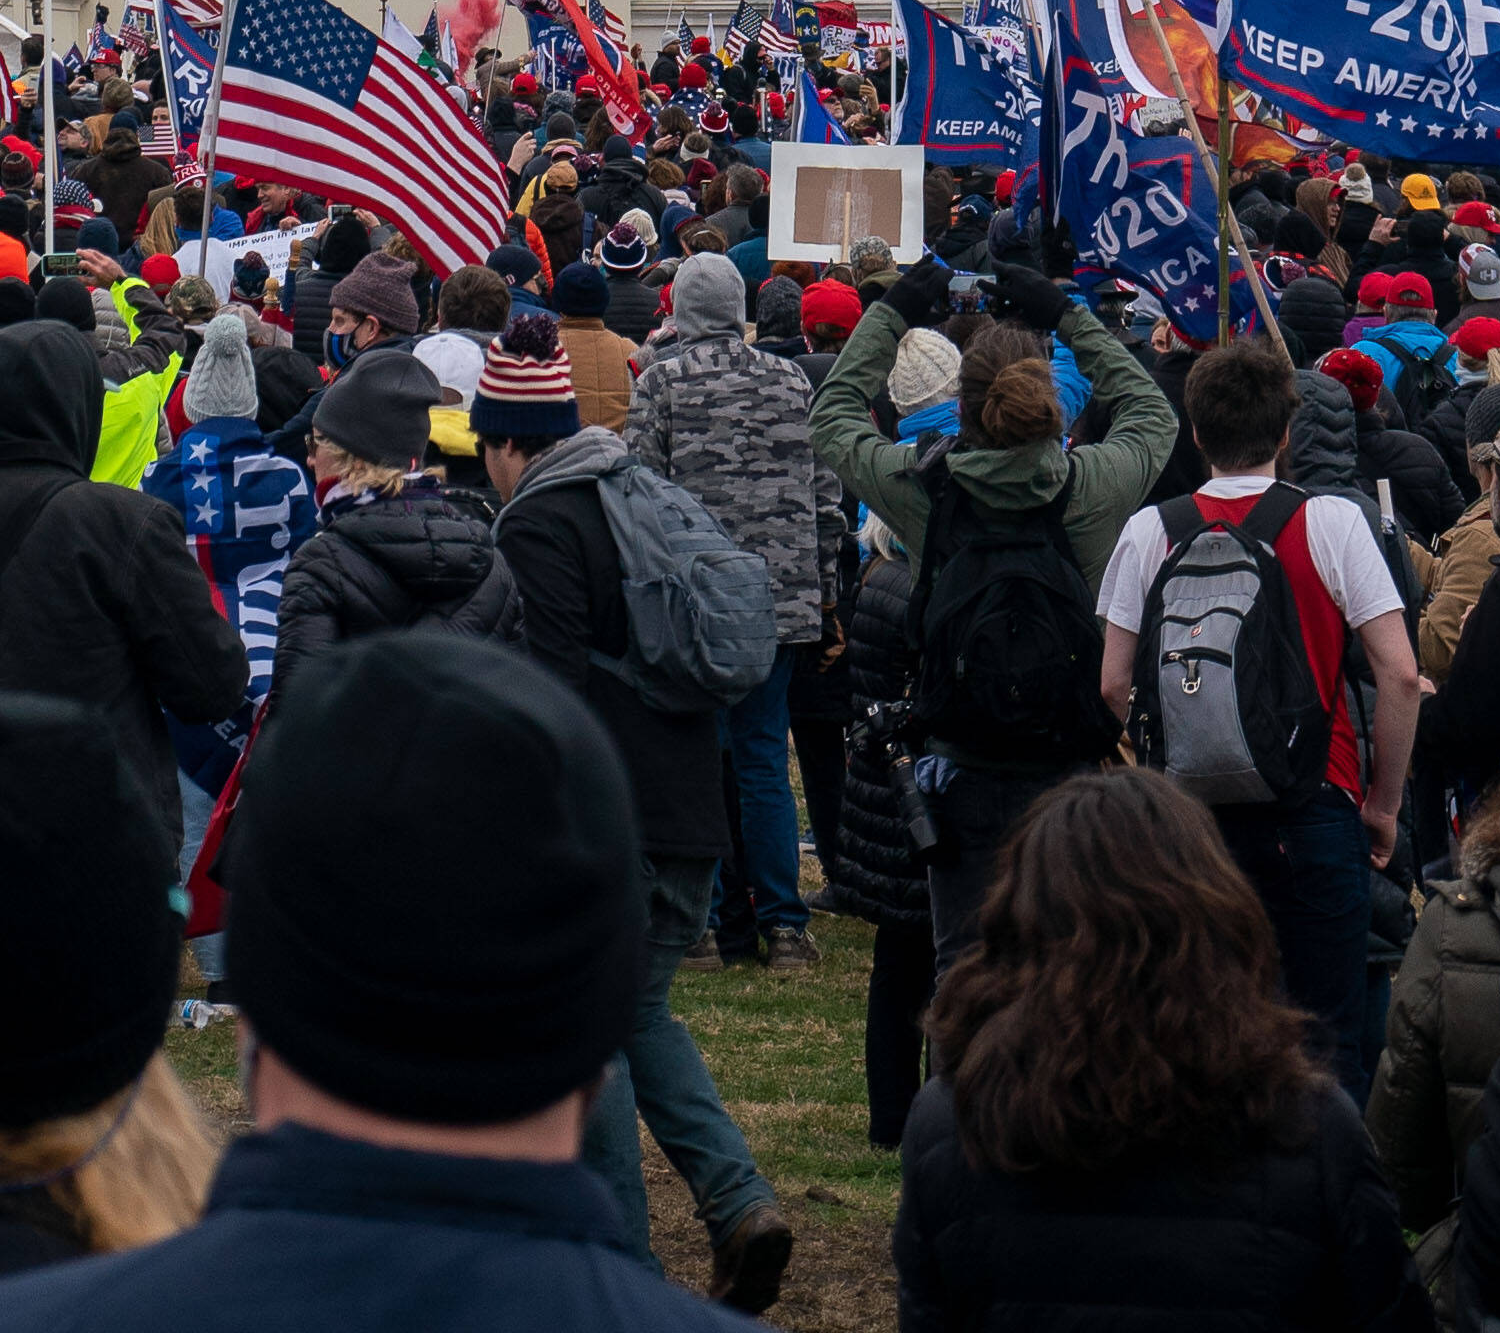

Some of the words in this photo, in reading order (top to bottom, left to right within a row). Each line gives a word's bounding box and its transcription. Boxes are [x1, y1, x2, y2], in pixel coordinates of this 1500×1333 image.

[1242, 19, 1324, 76] KEEP
[935, 119, 984, 136] KEEP
[253, 233, 274, 244] won
